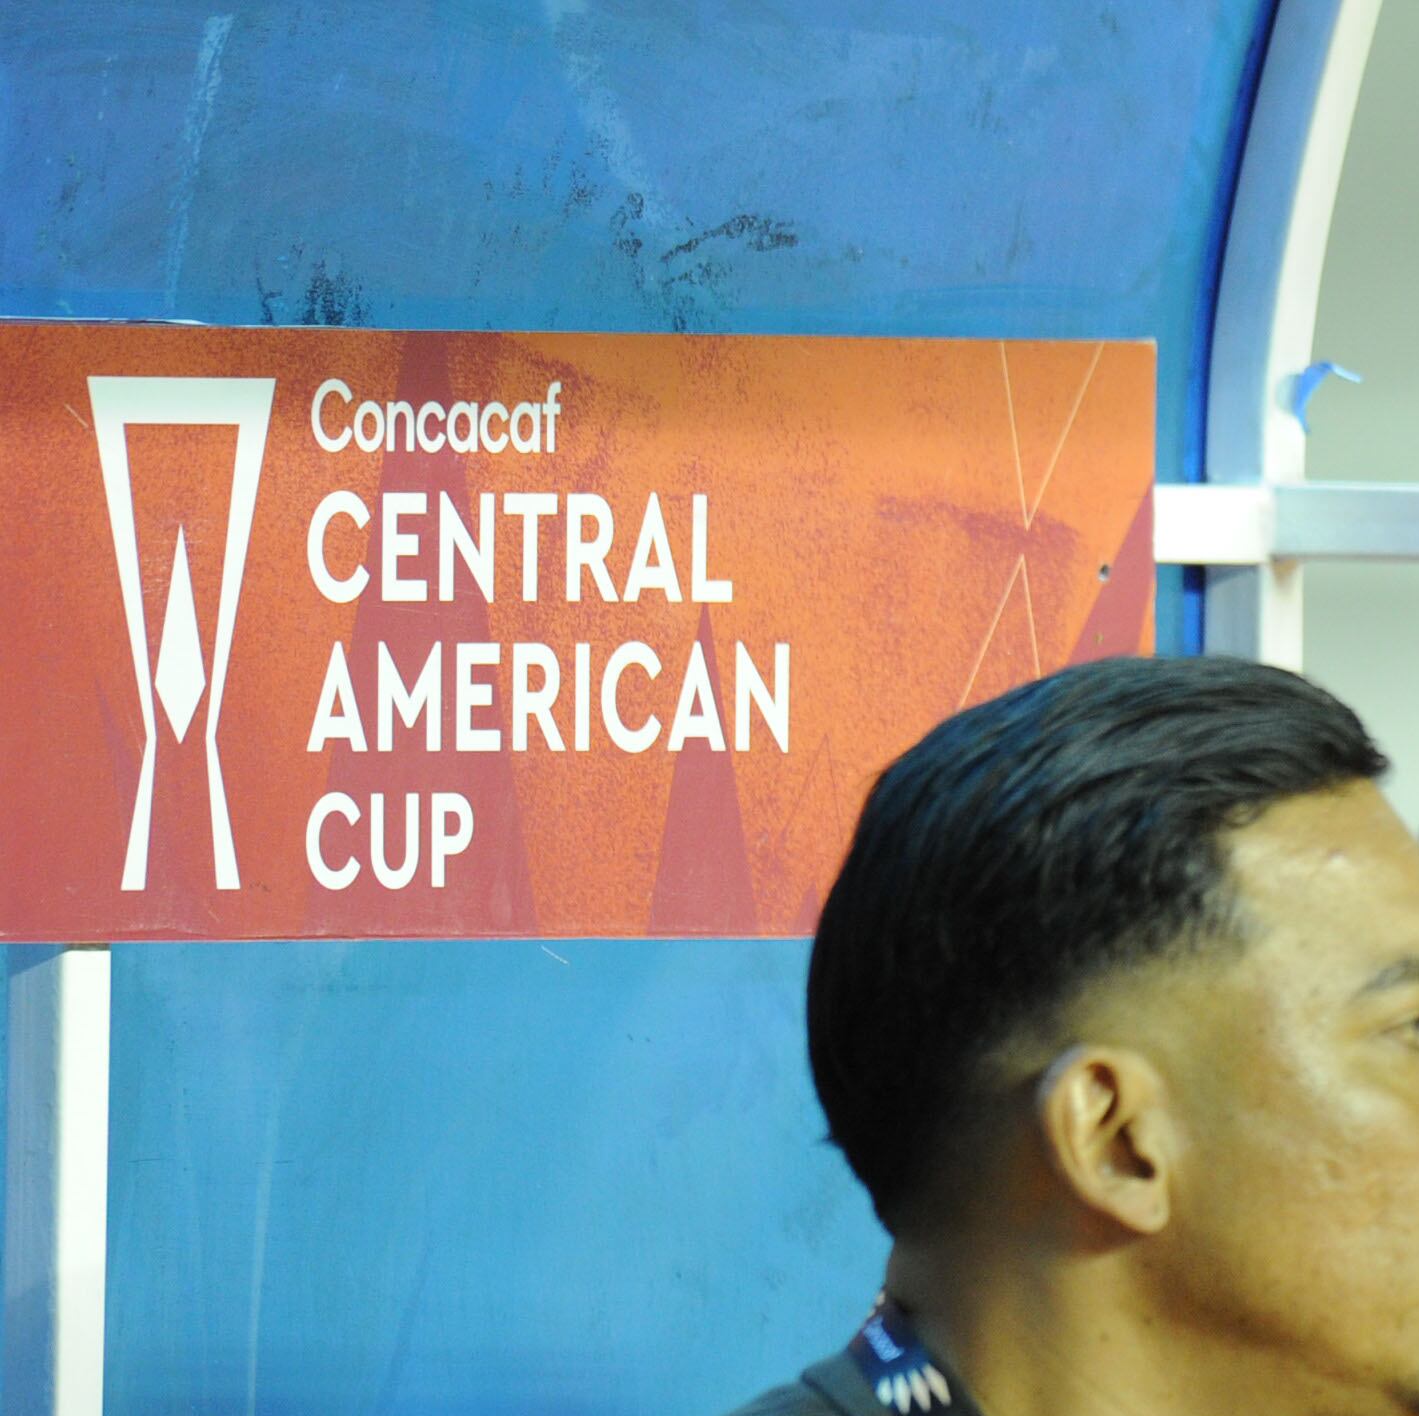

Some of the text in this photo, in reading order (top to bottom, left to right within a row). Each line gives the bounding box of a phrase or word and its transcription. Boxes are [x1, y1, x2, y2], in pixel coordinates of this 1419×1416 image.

[310, 378, 563, 454] Concacaf
[306, 490, 733, 604] CENTRAL
[306, 640, 790, 754] AMERICAN
[305, 791, 475, 890] CUP
